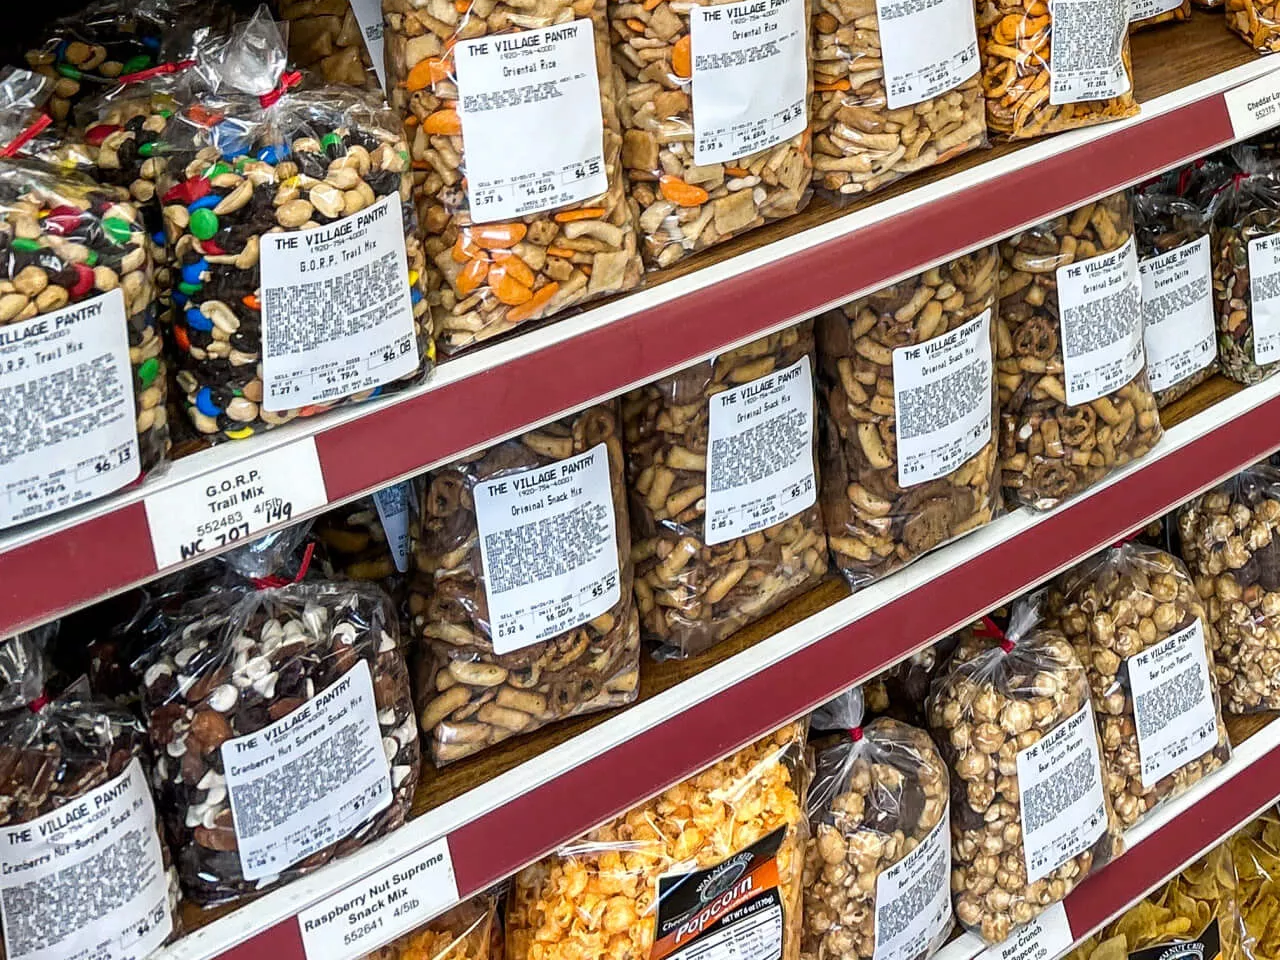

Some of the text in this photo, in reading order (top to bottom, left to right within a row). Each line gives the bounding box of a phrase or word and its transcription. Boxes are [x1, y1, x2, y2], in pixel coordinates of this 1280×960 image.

[702, 11, 721, 23] THE
[726, 2, 766, 19] VILLAGE
[467, 26, 579, 57] THE VILLAGE PANTRY
[732, 26, 761, 40] Oriental
[503, 60, 557, 78] Oriental Rice
[1248, 95, 1271, 112] Cheddar
[275, 204, 388, 249] THE VILLAGE PANTRY
[1149, 244, 1202, 272] VILLAGE PANTRY
[55, 302, 103, 323] PANTRY
[904, 319, 984, 361] THE VILLAGE PANTRY
[721, 366, 804, 407] THE VILLAGE PANTRY
[95, 448, 131, 473] $6.13
[488, 454, 595, 497] THE VILLAGE PANTRY
[205, 470, 262, 498] G.O.R.P.
[208, 485, 265, 516] Trail Mix
[196, 512, 243, 537] 552483
[1151, 629, 1197, 660] VILLAGE PANTRY
[234, 677, 352, 753] THE VILLAGE PANTRY
[1041, 711, 1088, 754] VILLAGE PANTRY
[8, 777, 133, 846] THE VILLAGE PANTRY
[303, 851, 444, 933] Raspberry Nut Supreme
[348, 885, 409, 926] Snack Mix
[344, 898, 420, 945] 552641 4/5lb
[675, 876, 752, 943] Popcorn
[1002, 926, 1042, 959] Bear Crunch
